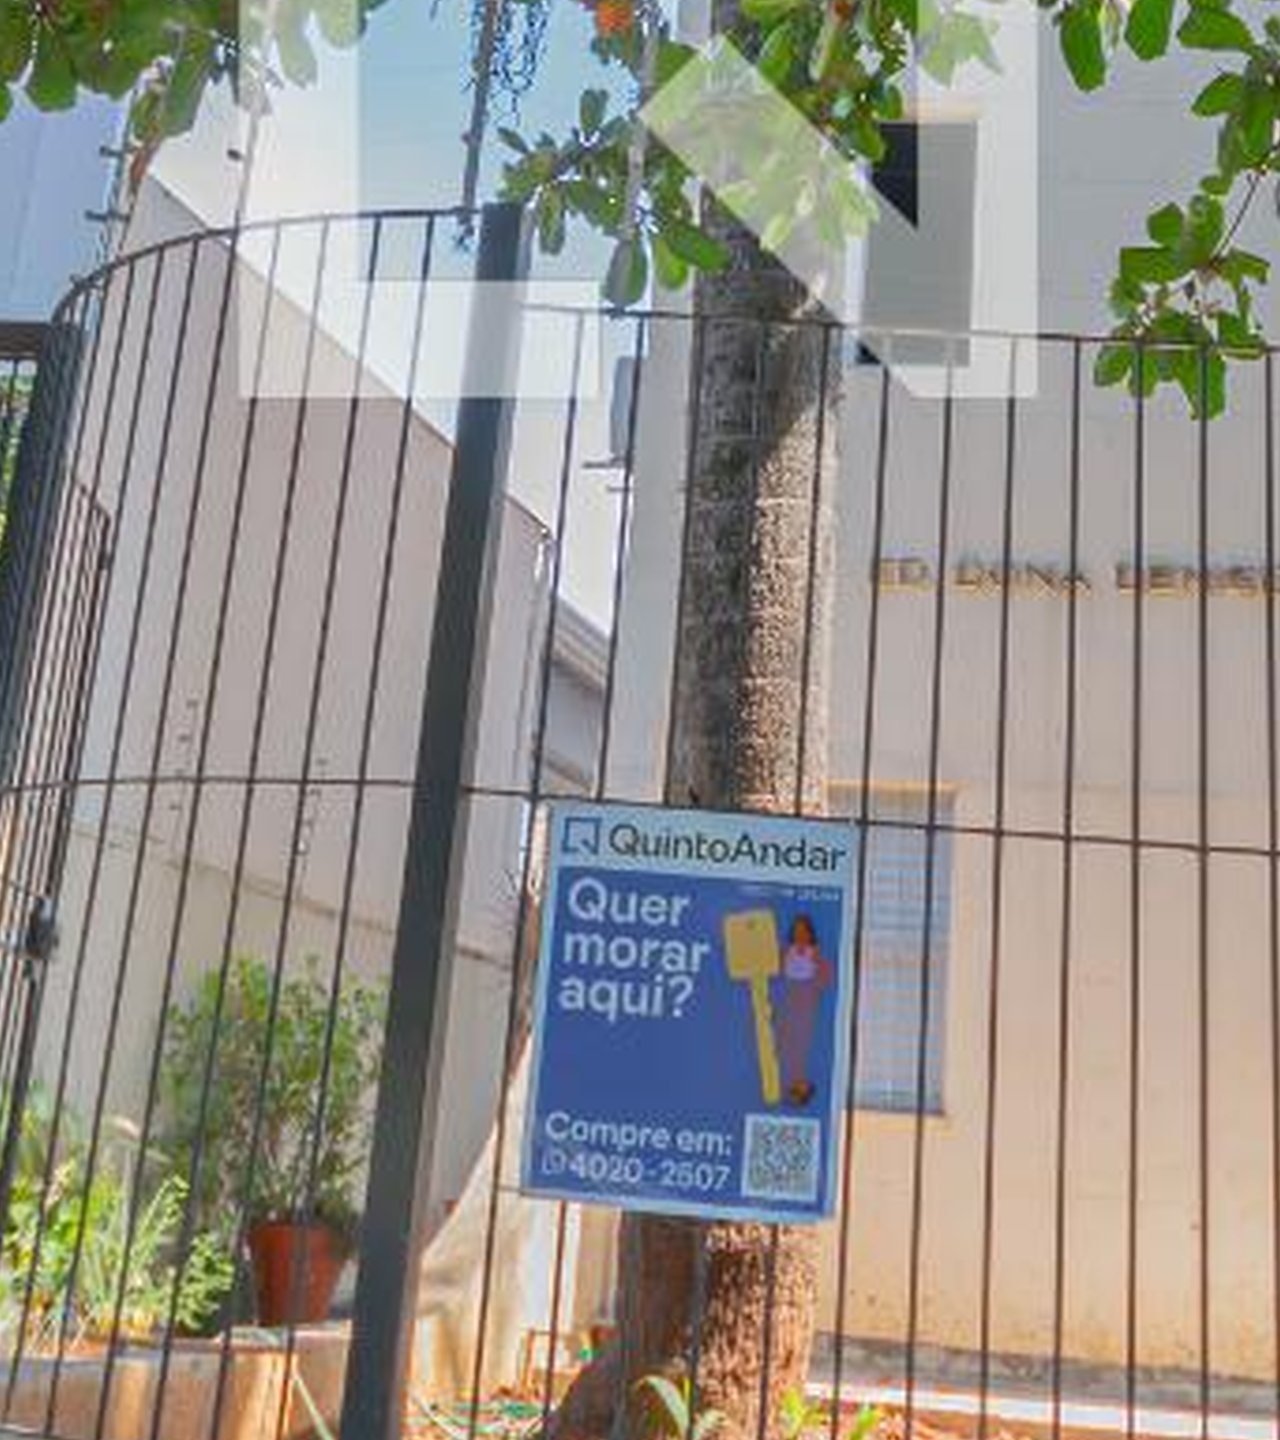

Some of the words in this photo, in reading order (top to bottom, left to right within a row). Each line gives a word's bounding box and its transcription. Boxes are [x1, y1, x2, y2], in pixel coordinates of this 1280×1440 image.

[609, 823, 846, 871] QuintoAndar
[568, 877, 690, 926] Quer
[563, 930, 710, 972] morar
[559, 974, 693, 1023] aqui?
[545, 1110, 670, 1152] Compre
[676, 1128, 733, 1157] em:
